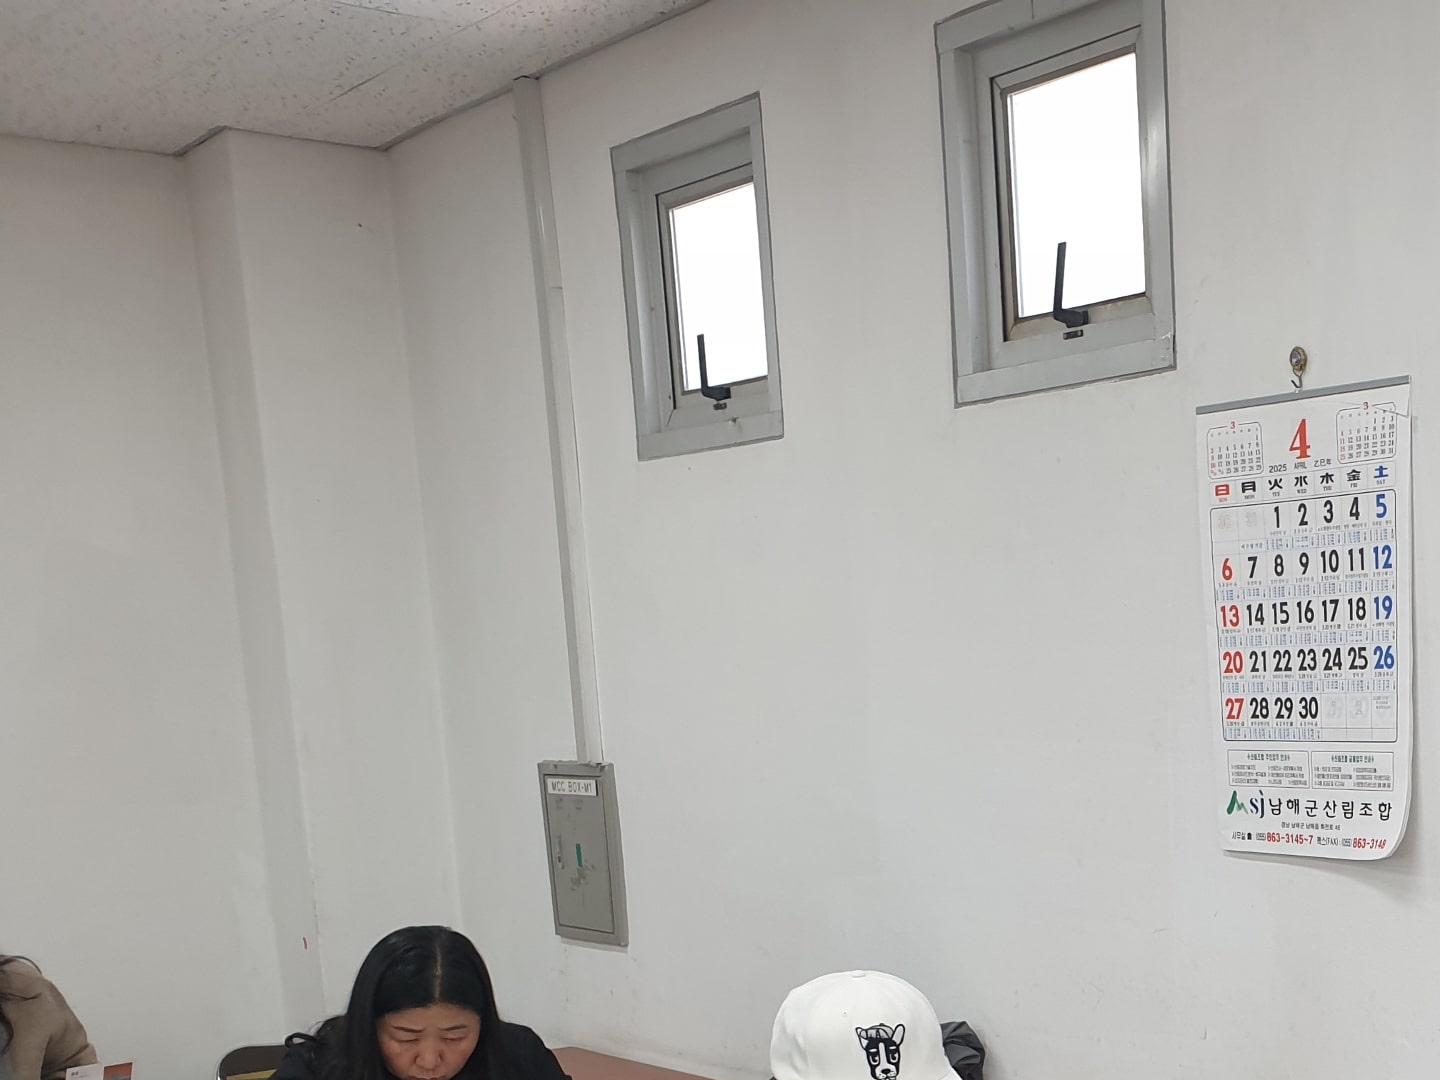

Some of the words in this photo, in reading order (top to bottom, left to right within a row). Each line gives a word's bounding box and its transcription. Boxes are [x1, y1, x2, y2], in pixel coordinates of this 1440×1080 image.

[1231, 421, 1235, 429] 3
[1289, 418, 1310, 459] 4
[1242, 481, 1256, 493] 月
[1268, 478, 1283, 490] 火
[1294, 475, 1308, 487] 水
[1320, 473, 1334, 484] 木
[1347, 469, 1361, 481] 金
[1374, 466, 1388, 478] 土
[1269, 464, 1287, 473] 2025
[1274, 506, 1279, 528] 1
[1298, 503, 1308, 526] 2
[1323, 500, 1333, 523] 3
[1350, 497, 1360, 520] 4
[1376, 494, 1387, 518] 5
[1222, 558, 1233, 580] 6
[1248, 556, 1257, 578] 7
[1274, 554, 1284, 576] 8
[1299, 552, 1309, 575] 9
[1321, 550, 1339, 573] 10
[1348, 547, 1364, 571] 11
[1373, 545, 1392, 569] 12
[1220, 605, 1239, 627] 13
[1247, 603, 1264, 626] 14
[1272, 602, 1289, 624] 15
[1297, 600, 1314, 623] 16
[1322, 599, 1339, 622] 17
[1348, 597, 1366, 620] 18
[1374, 595, 1392, 620] 19
[1223, 651, 1243, 673] 20
[1249, 650, 1266, 672] 21
[1273, 650, 1292, 672] 22
[1297, 649, 1317, 671] 23
[1322, 648, 1342, 670] 24
[1348, 647, 1368, 670] 25
[1374, 645, 1394, 669] 26
[1225, 698, 1244, 719] 27
[1250, 697, 1269, 719] 28
[1274, 697, 1293, 719] 29
[1299, 697, 1318, 719] 30
